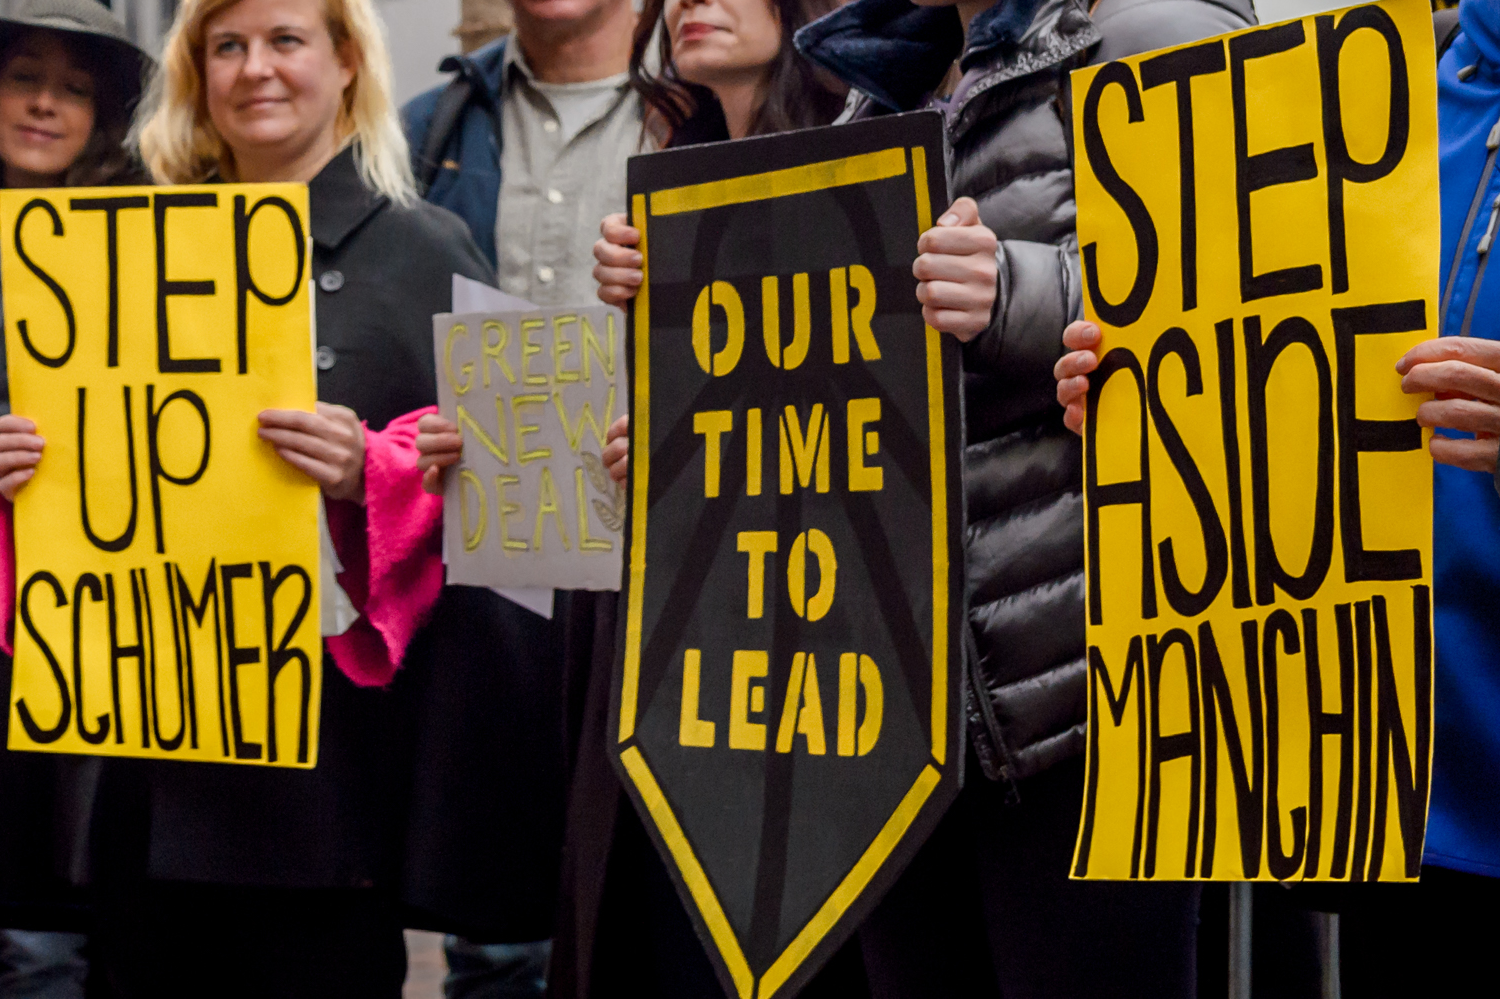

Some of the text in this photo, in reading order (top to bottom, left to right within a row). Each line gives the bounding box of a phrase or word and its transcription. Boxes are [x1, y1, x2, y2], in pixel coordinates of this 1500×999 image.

[1081, 3, 1410, 329] STEP
[14, 192, 306, 374] STEP
[691, 264, 882, 378] OUR
[443, 312, 616, 396] GREEN
[77, 384, 211, 554] UP
[456, 383, 616, 466] NEW
[693, 397, 884, 499] TIME
[1084, 298, 1428, 626] ASIDE
[457, 466, 614, 554] DEAL
[736, 527, 838, 623] TO
[15, 557, 313, 763] SCHUMER
[678, 648, 885, 758] LEAD
[1074, 585, 1431, 882] MANCHIN
